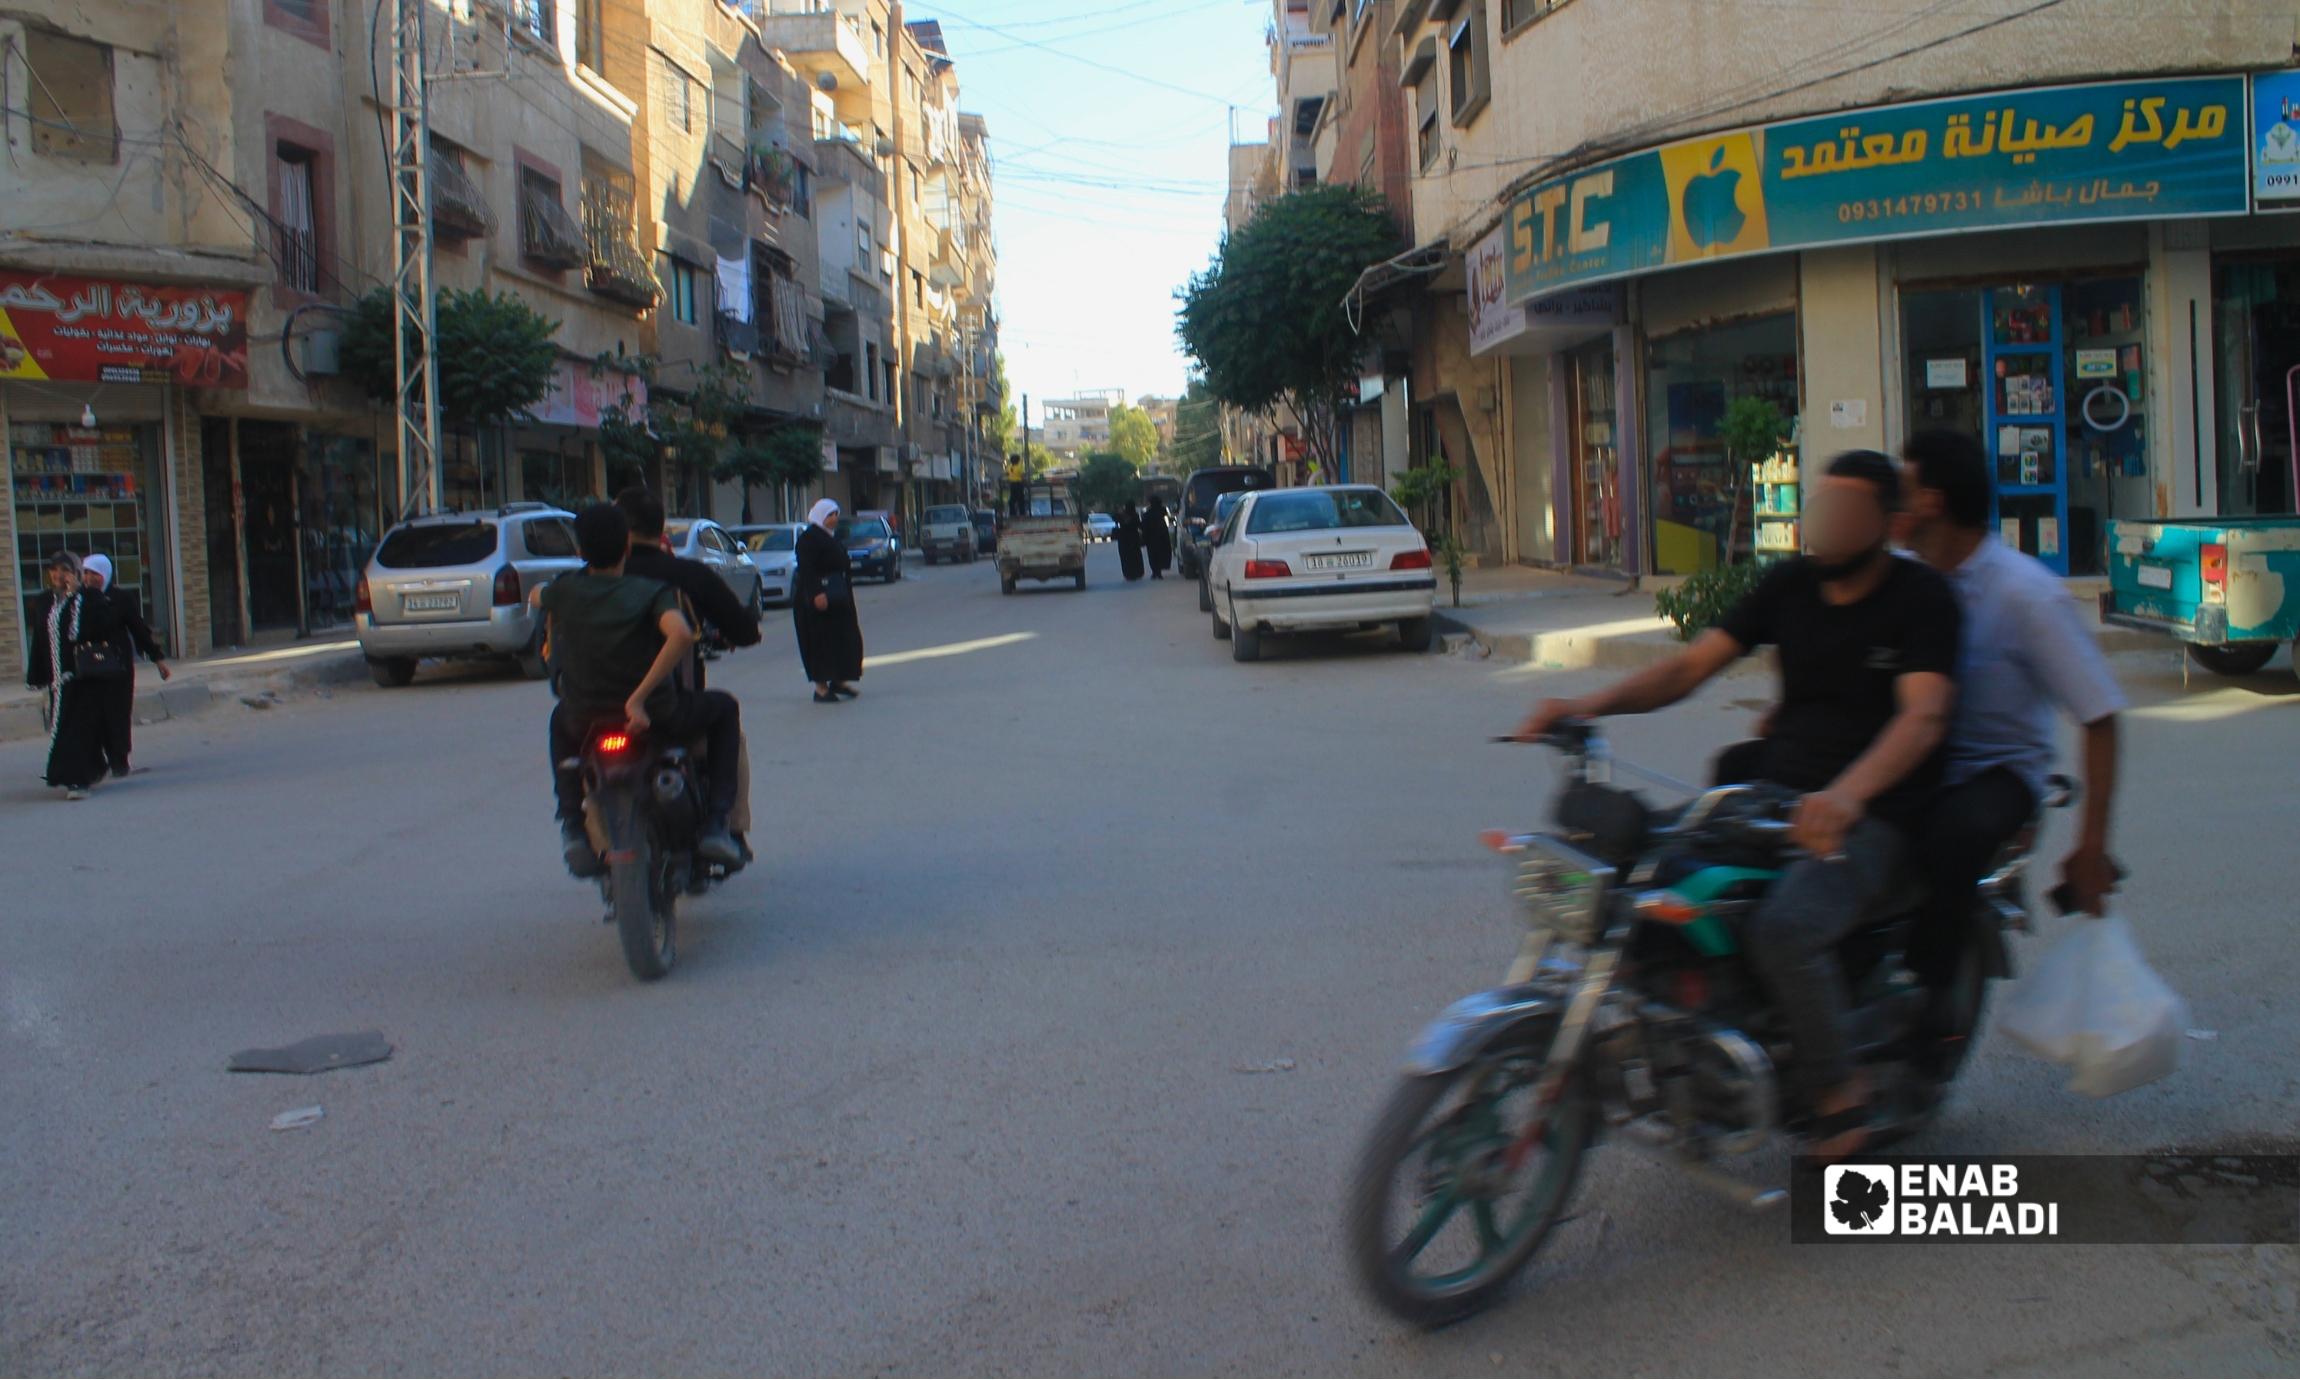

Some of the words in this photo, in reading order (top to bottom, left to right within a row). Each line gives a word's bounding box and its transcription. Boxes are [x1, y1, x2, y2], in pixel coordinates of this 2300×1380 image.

[1942, 109, 2094, 165] صيانة
[2107, 97, 2227, 154] مركز
[1780, 126, 1928, 180] معتمد
[1837, 190, 1983, 223] 0931479731
[2079, 179, 2161, 206] جمال
[1569, 257, 1606, 273] Center
[0, 283, 111, 322] الرحم
[117, 285, 233, 335] بزورية
[97, 328, 126, 340] غذائية
[127, 331, 149, 343] مواد
